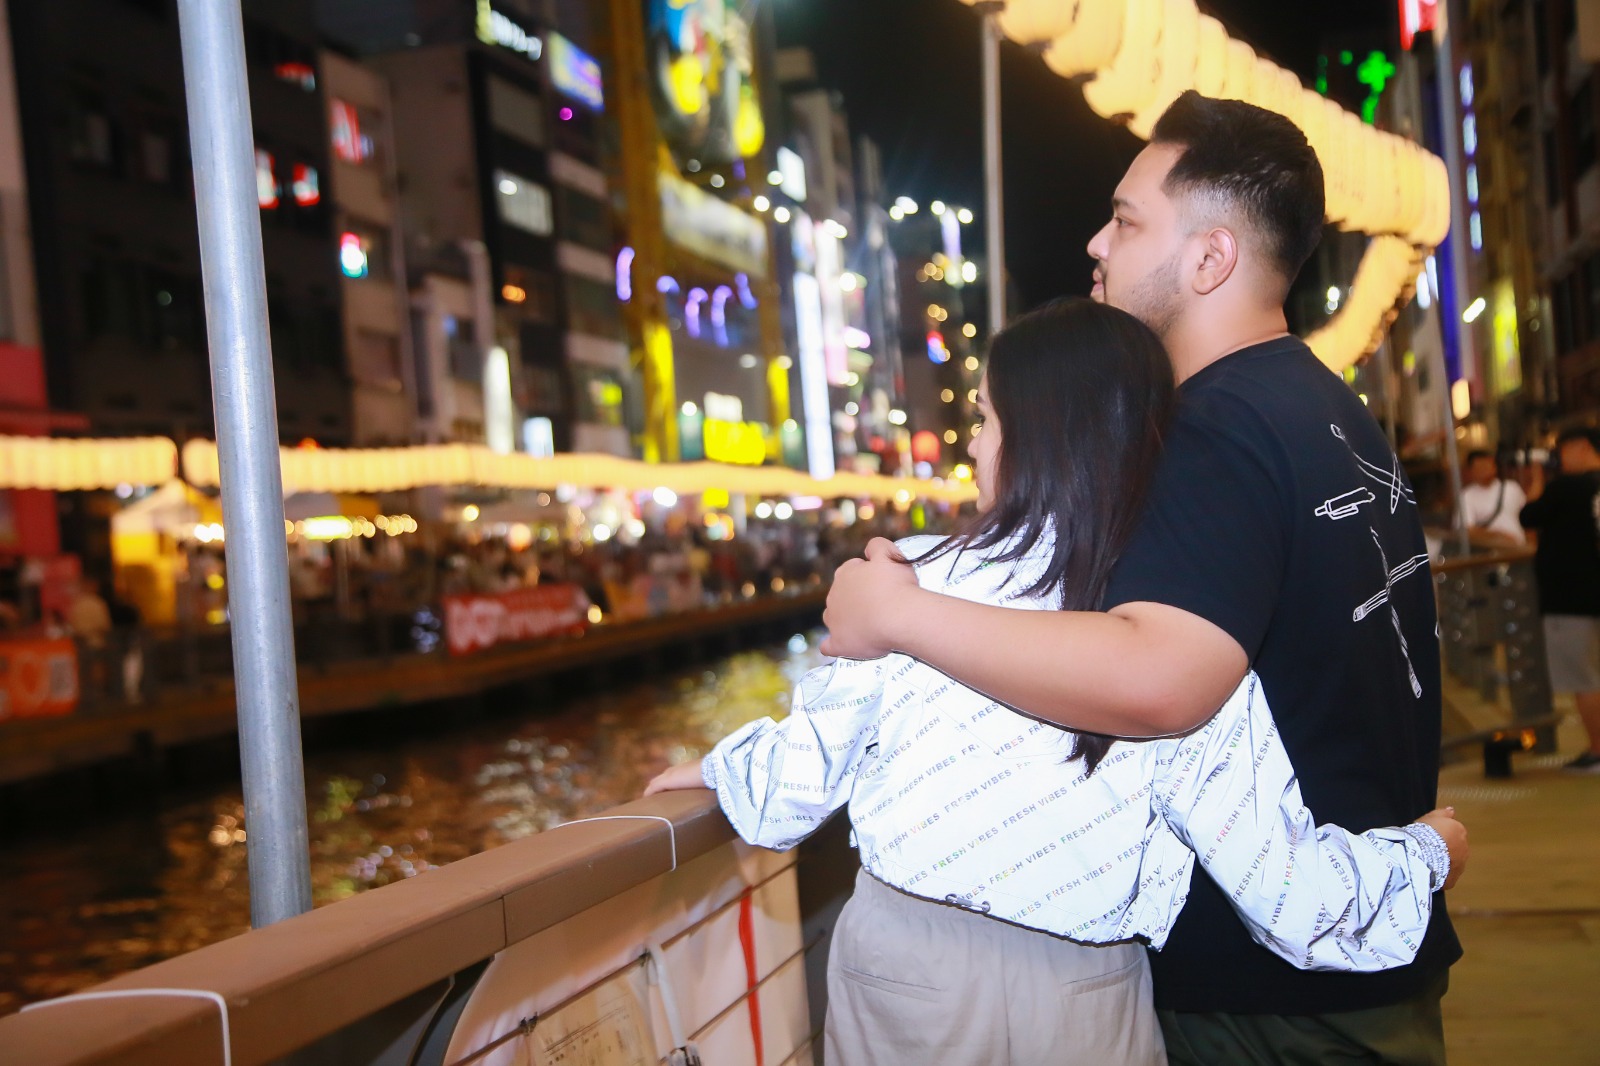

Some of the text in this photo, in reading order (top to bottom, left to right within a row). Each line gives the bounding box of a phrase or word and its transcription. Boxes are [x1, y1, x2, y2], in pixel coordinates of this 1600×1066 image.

[820, 701, 847, 713] FRESH
[847, 693, 878, 708] VIBES
[971, 702, 999, 723] FRES
[787, 742, 812, 752] IBES
[827, 738, 855, 753] VIBES
[884, 740, 912, 764] VIBES
[915, 716, 941, 741] FRESH
[992, 735, 1025, 756] VIBES
[1182, 740, 1205, 772] VIBES
[1207, 716, 1248, 783] FRESH VIBES
[1253, 739, 1271, 768] RESH
[778, 781, 810, 792] FRESH
[868, 755, 957, 817] VIBES FRESH VIBES
[764, 816, 782, 824] ESH
[881, 831, 909, 854] FRESH
[911, 812, 941, 834] VIBES
[980, 769, 1012, 791] VIBES
[932, 847, 967, 872] FRESH
[967, 827, 999, 849] VIBES
[1002, 804, 1037, 828] FRESH
[1037, 787, 1068, 807] VIBES
[1102, 750, 1136, 768] VIBES
[989, 861, 1024, 885] FRESH
[1025, 842, 1057, 864] VIBES
[1060, 822, 1093, 844] FRESH
[1093, 803, 1123, 825] VIBES
[1202, 847, 1217, 865] BES
[1215, 810, 1241, 843] FRESH
[1045, 878, 1082, 901] FRESH
[1082, 862, 1113, 882] VIBES
[1233, 838, 1271, 902] FRESH VIBES
[1284, 847, 1297, 886] FRESH
[1328, 854, 1353, 891] FRESH
[1270, 893, 1287, 925] VIBES
[1064, 919, 1098, 937] VIBES
[1398, 931, 1417, 951] BES
